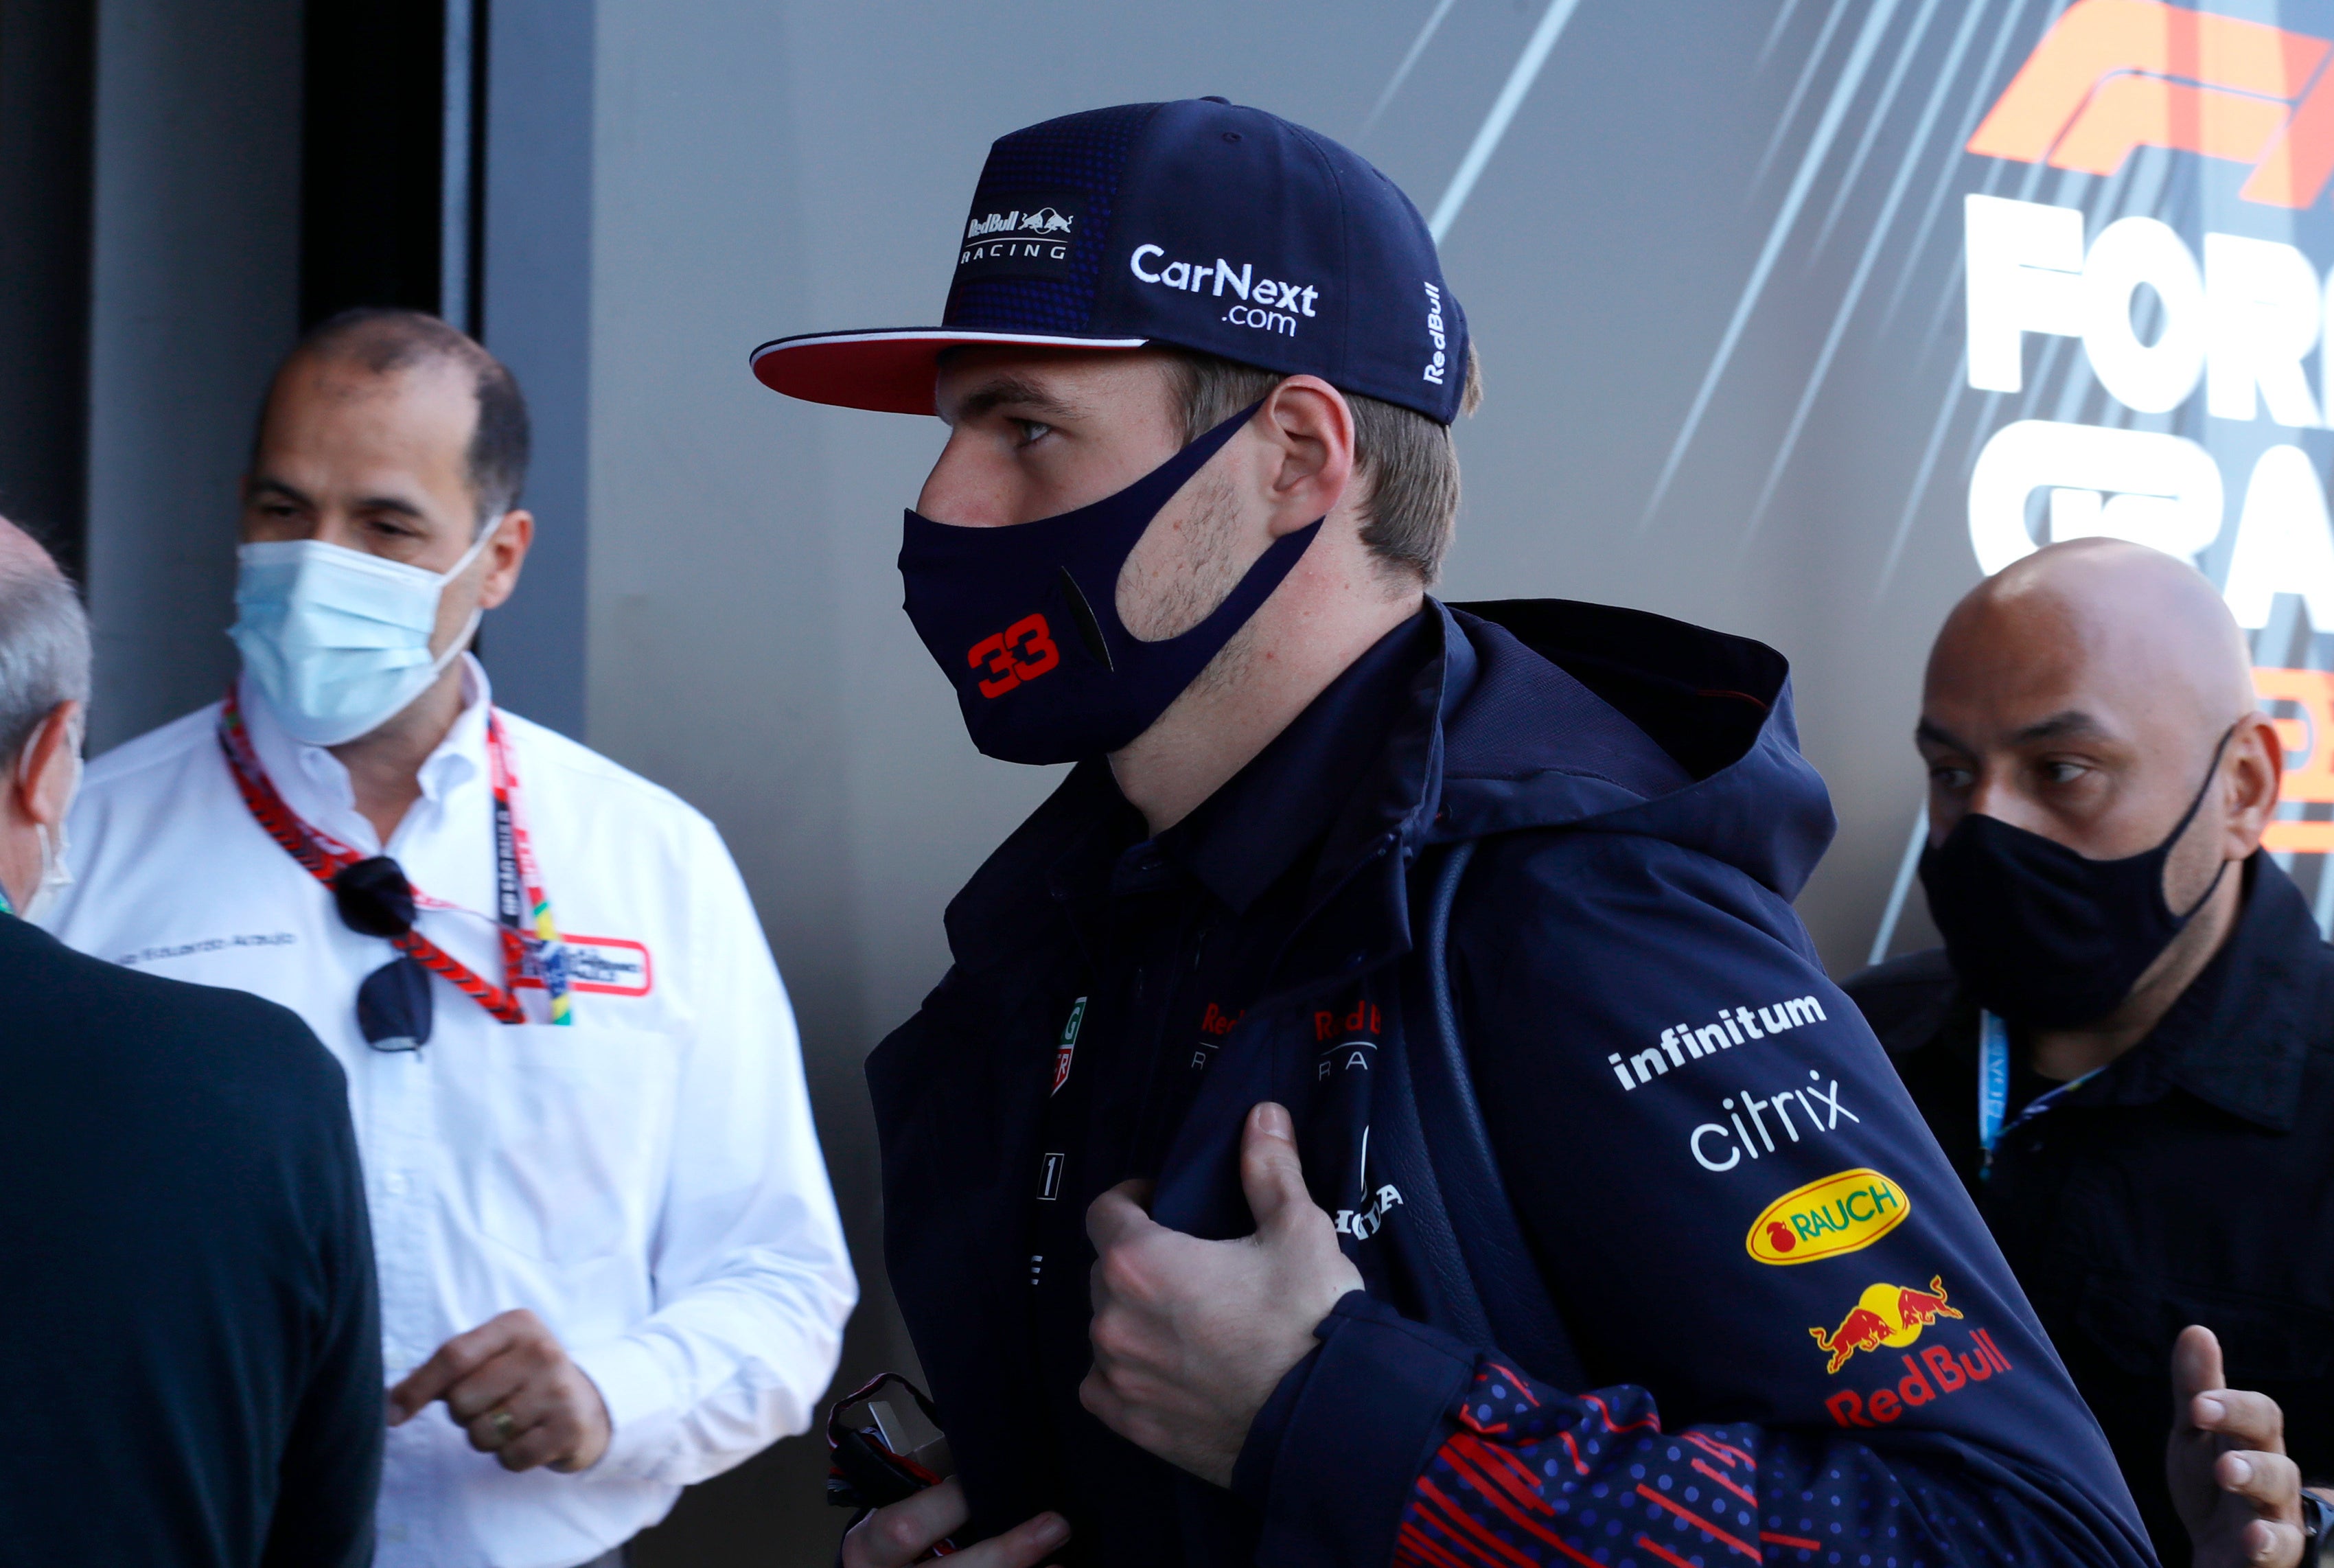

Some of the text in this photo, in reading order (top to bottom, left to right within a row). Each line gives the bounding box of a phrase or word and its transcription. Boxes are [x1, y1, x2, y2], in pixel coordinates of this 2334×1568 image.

[961, 244, 1066, 264] RACING
[1130, 244, 1319, 317] CarNext
[1221, 305, 1297, 337] .com
[1965, 194, 2334, 429] FOR
[967, 612, 1060, 699] 33
[1608, 995, 1827, 1091] infinitum
[1690, 1069, 1860, 1173] citrix
[1792, 1184, 1899, 1243] RAUCH
